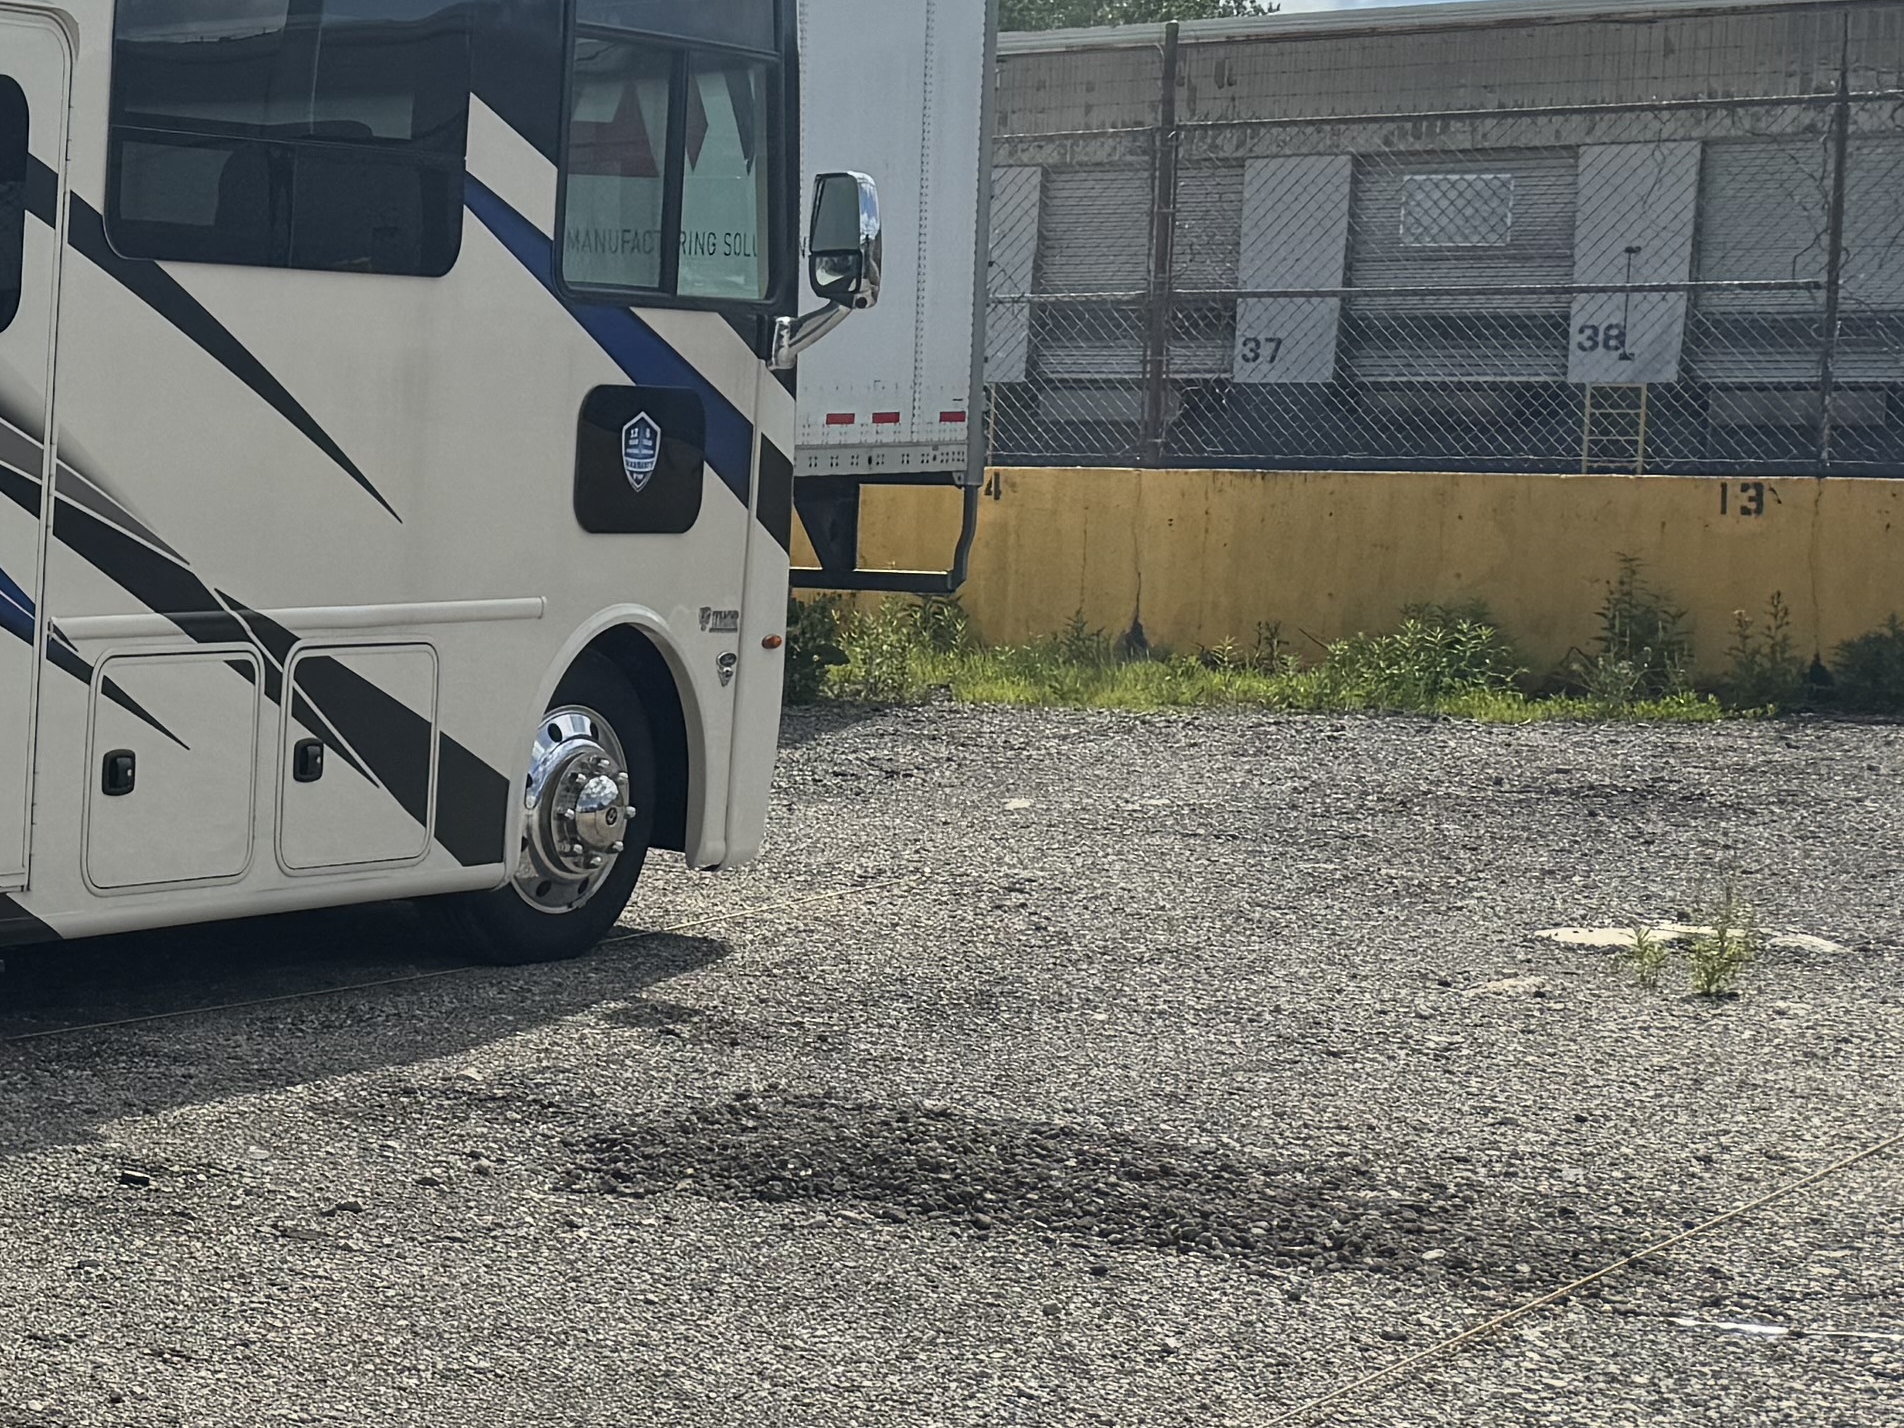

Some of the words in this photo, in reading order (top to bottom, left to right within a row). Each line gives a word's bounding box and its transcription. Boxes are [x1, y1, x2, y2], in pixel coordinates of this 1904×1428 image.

[566, 228, 717, 258] MANUFACRING
[1242, 337, 1282, 364] 37
[1577, 323, 1626, 352] 38
[1720, 481, 1765, 517] 13
